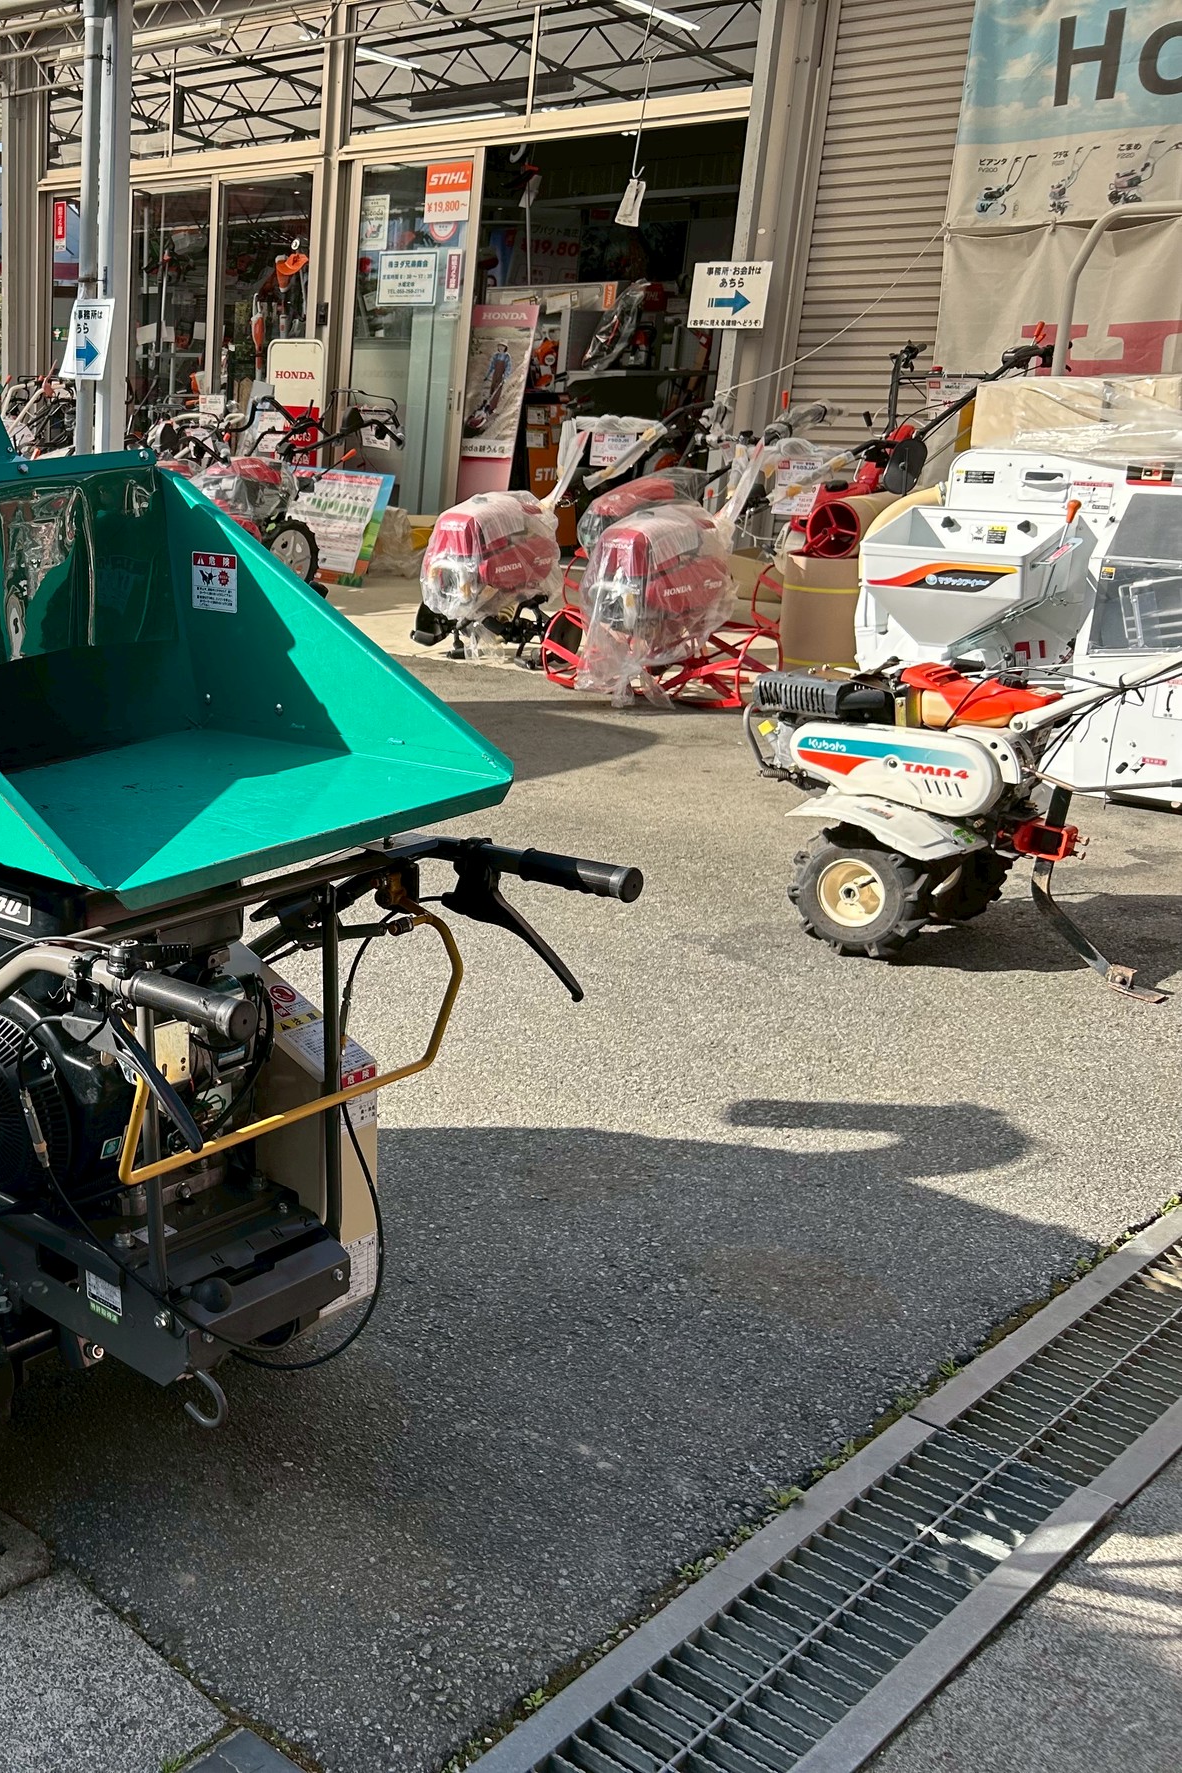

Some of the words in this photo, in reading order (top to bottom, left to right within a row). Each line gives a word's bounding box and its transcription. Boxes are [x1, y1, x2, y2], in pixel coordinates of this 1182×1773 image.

[429, 171, 468, 186] STIHL
[719, 277, 745, 288] あちら
[482, 312, 528, 320] HONDA
[275, 370, 315, 380] HONDA
[534, 467, 556, 482] STI
[209, 555, 230, 567] 危険
[494, 561, 523, 575] HONDA
[663, 584, 692, 598] HONDA
[808, 738, 847, 753] Kubota
[347, 1068, 370, 1085] 危険
[299, 1215, 313, 1228] 2
